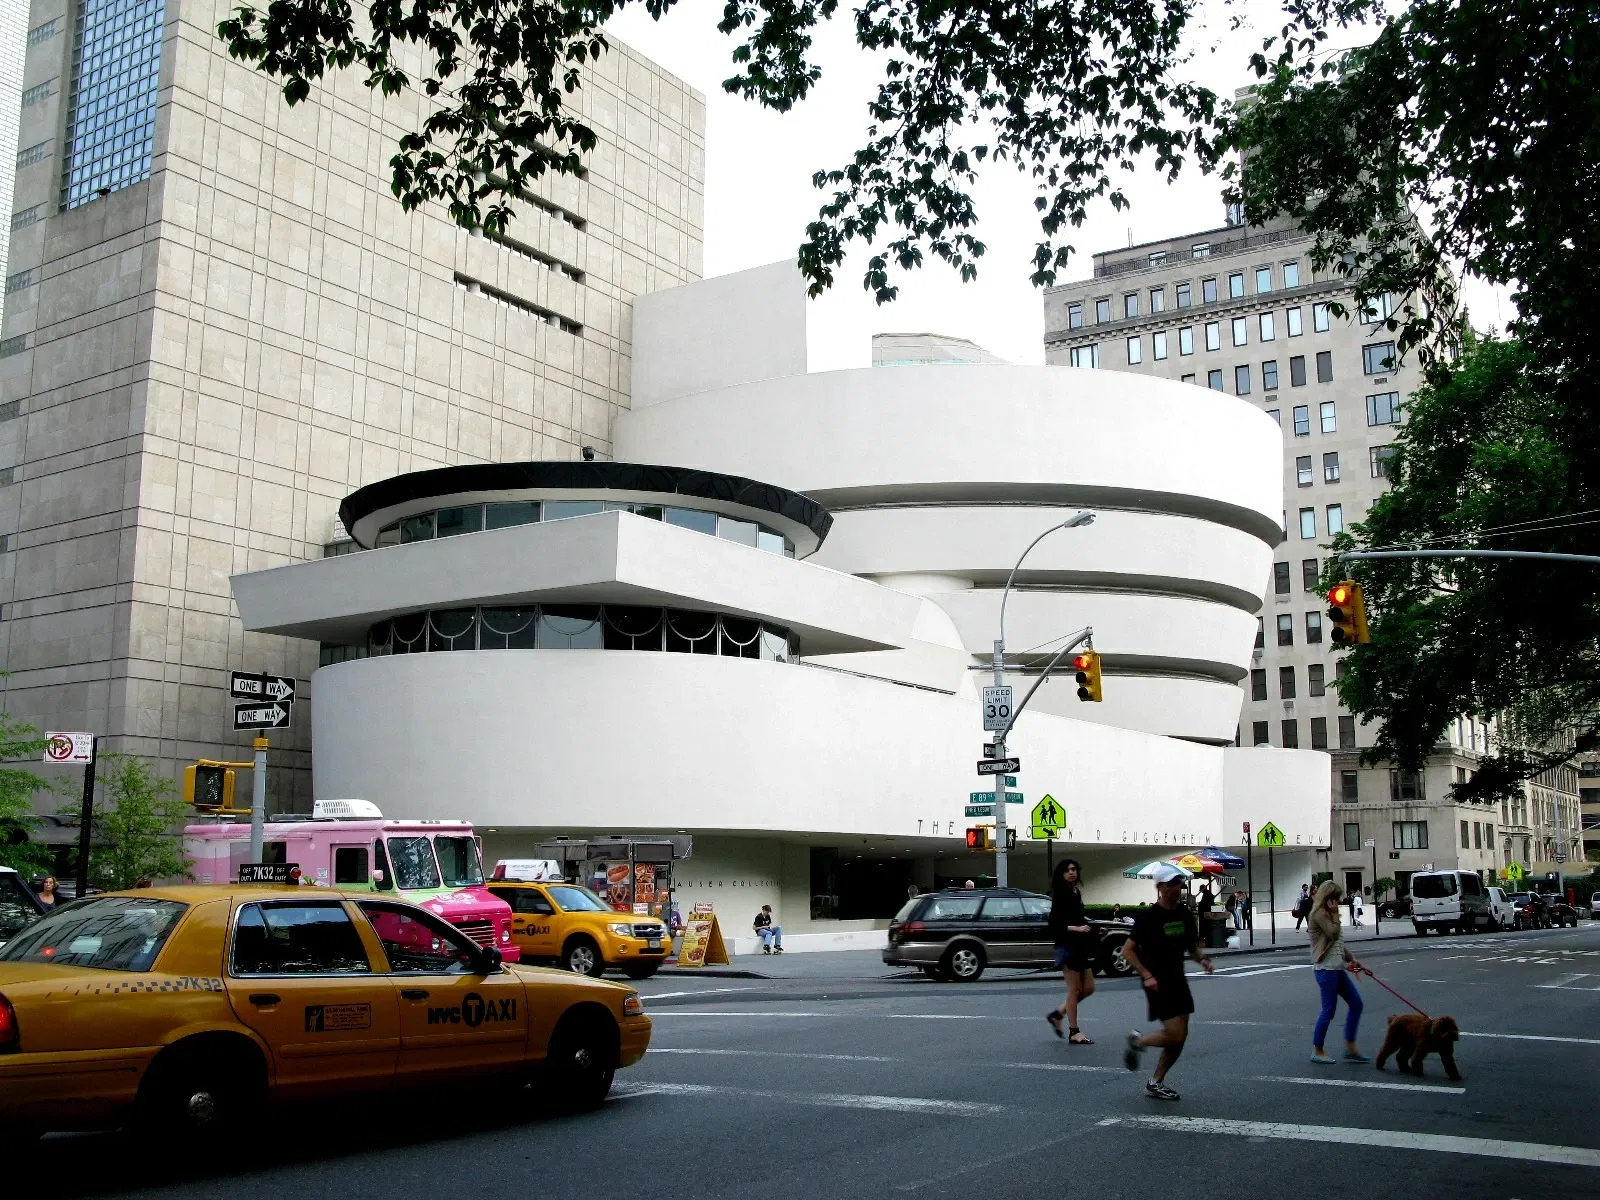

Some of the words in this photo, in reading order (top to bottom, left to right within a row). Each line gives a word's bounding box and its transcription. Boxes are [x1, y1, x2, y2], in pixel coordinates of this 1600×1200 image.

[240, 681, 257, 692] ONE
[270, 683, 287, 695] WAY
[242, 711, 257, 722] ONE
[265, 710, 282, 721] WAY
[987, 705, 1010, 718] 30
[972, 794, 977, 802] E
[979, 793, 987, 802] 89
[918, 819, 955, 835] THE
[1122, 831, 1211, 845] GUGGENHEIM
[253, 866, 274, 880] 7K32
[179, 976, 223, 993] 7K32
[427, 1006, 461, 1025] NYC
[461, 991, 517, 1028] TAXI
